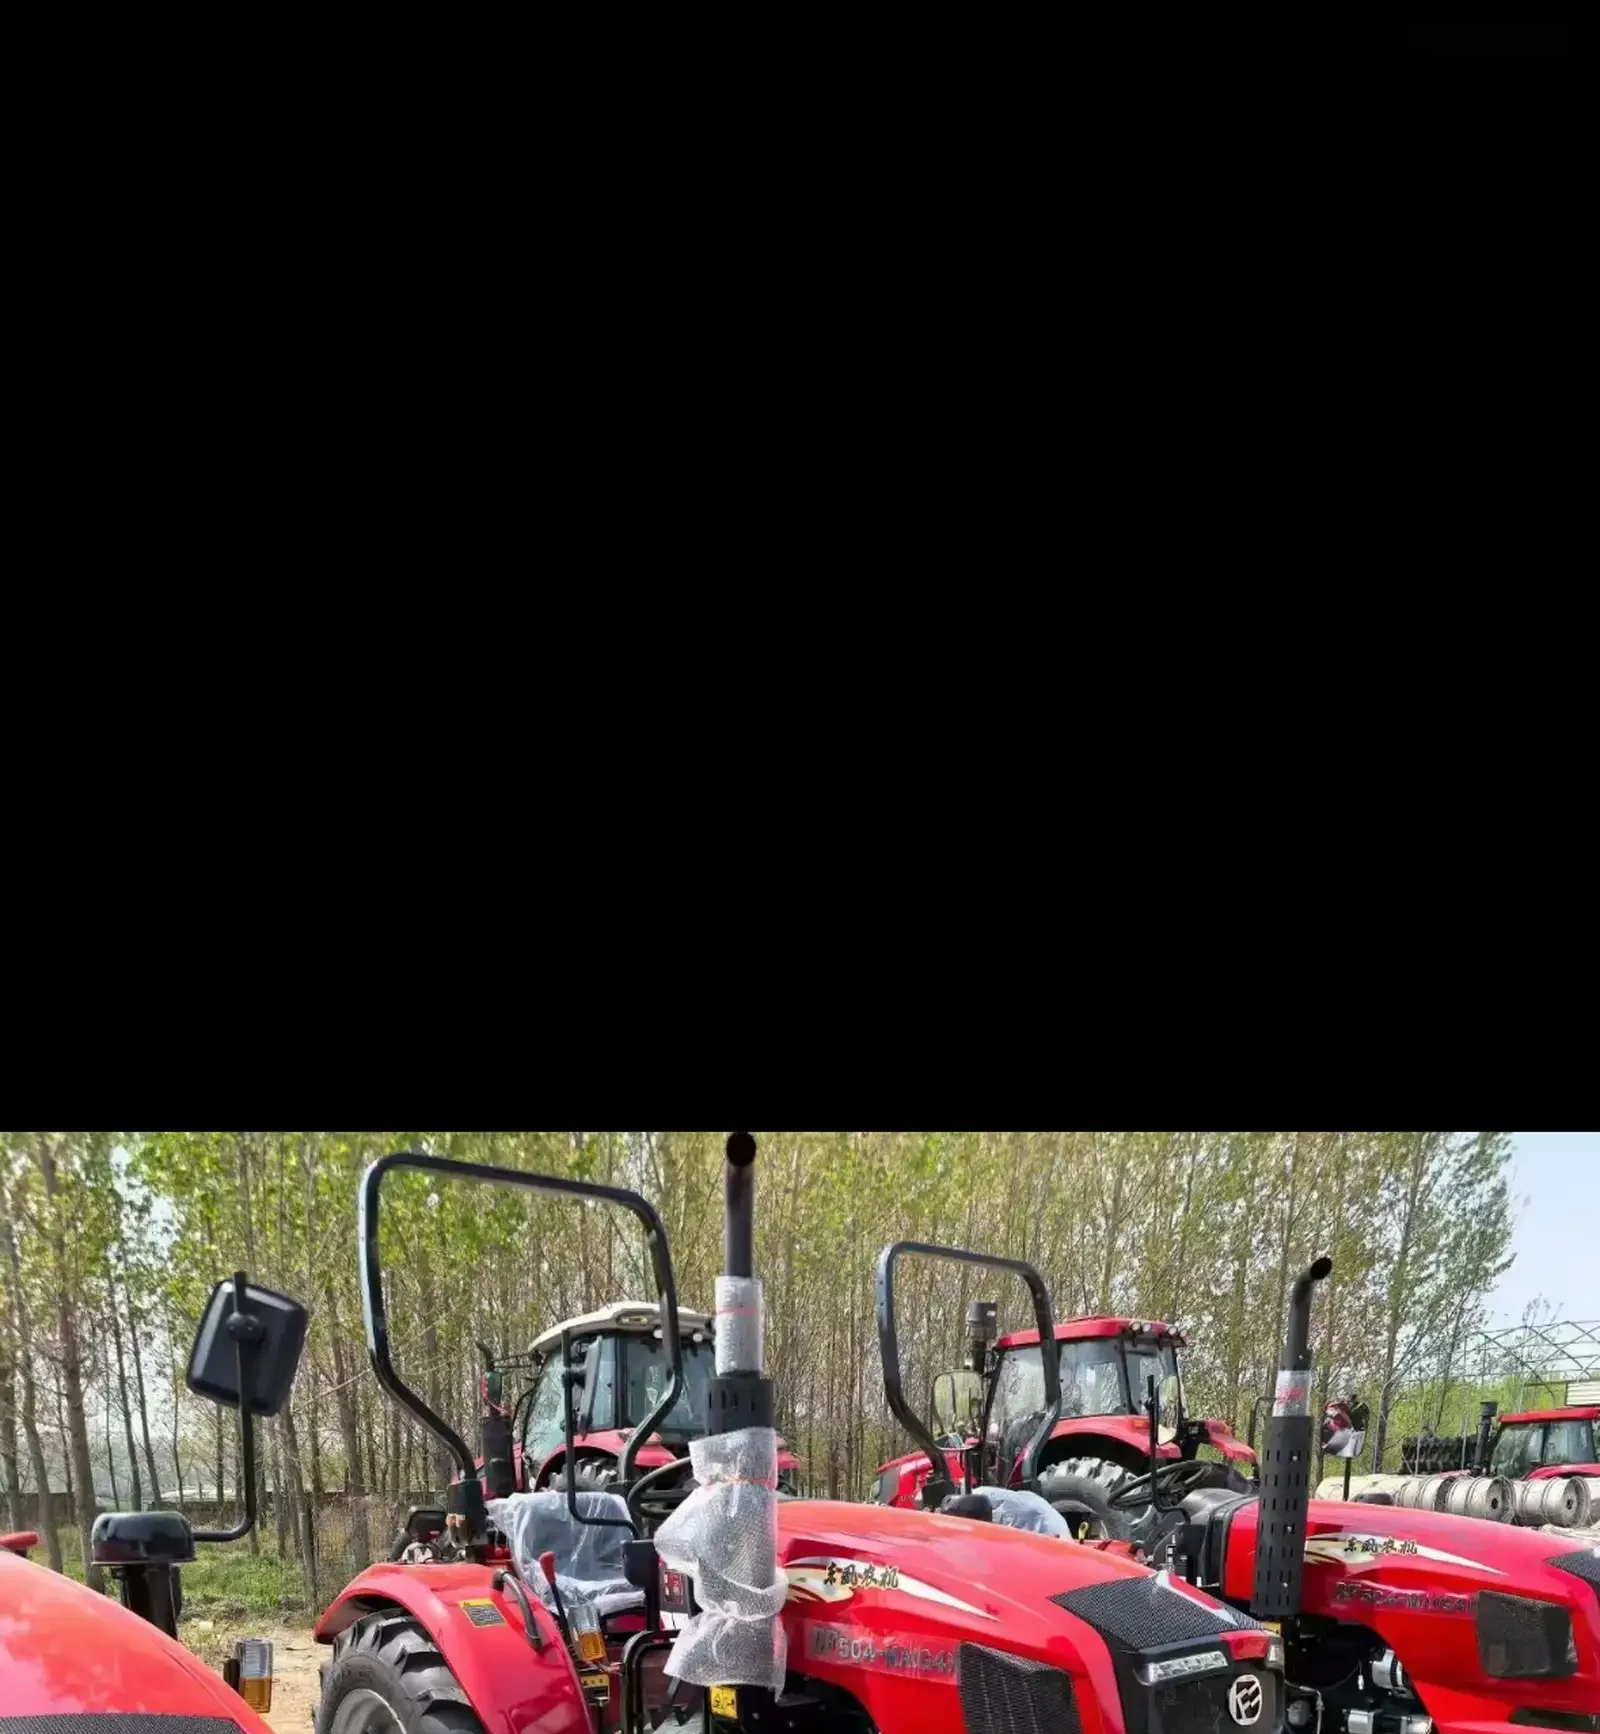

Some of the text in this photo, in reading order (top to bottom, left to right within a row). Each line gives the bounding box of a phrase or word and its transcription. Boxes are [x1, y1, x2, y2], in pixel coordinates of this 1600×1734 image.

[1344, 1536, 1418, 1555] 东风农机
[823, 1561, 900, 1589] 东风农机
